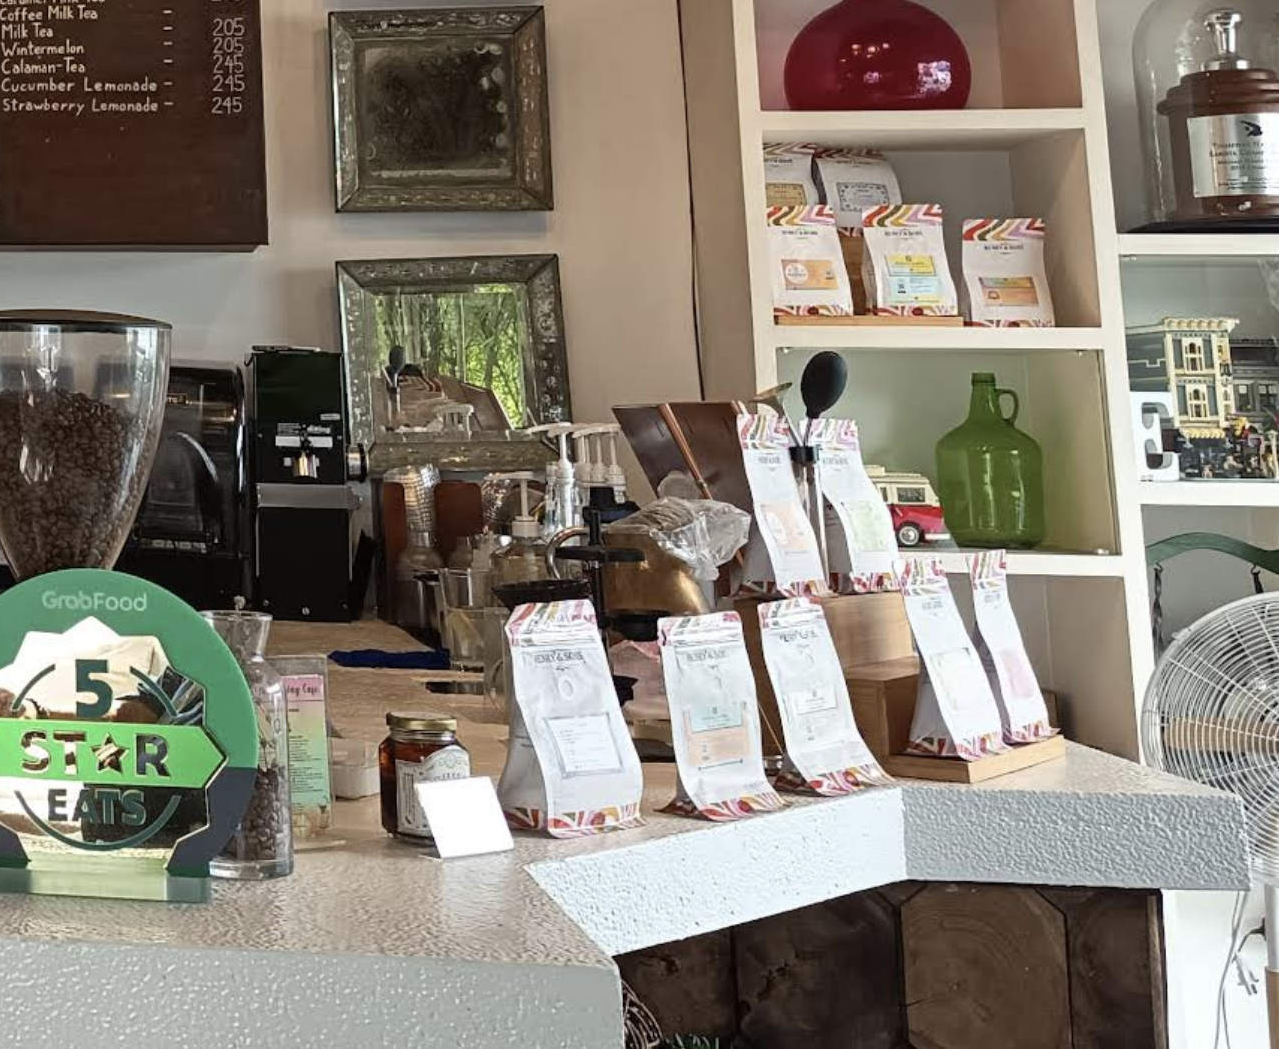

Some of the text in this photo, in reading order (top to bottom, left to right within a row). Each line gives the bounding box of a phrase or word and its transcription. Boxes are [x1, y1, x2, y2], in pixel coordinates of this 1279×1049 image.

[0, 5, 98, 22] Coffee Milk Tea
[1, 22, 53, 39] Milk Tea
[1, 39, 84, 56] Wintermelon
[1, 77, 157, 92] Cucumber Lemonade
[2, 97, 158, 116] Strawberry Lemonade
[41, 590, 147, 613] GrabFood
[75, 659, 113, 719] 5
[21, 730, 171, 779] STR
[47, 788, 147, 826] EATS
